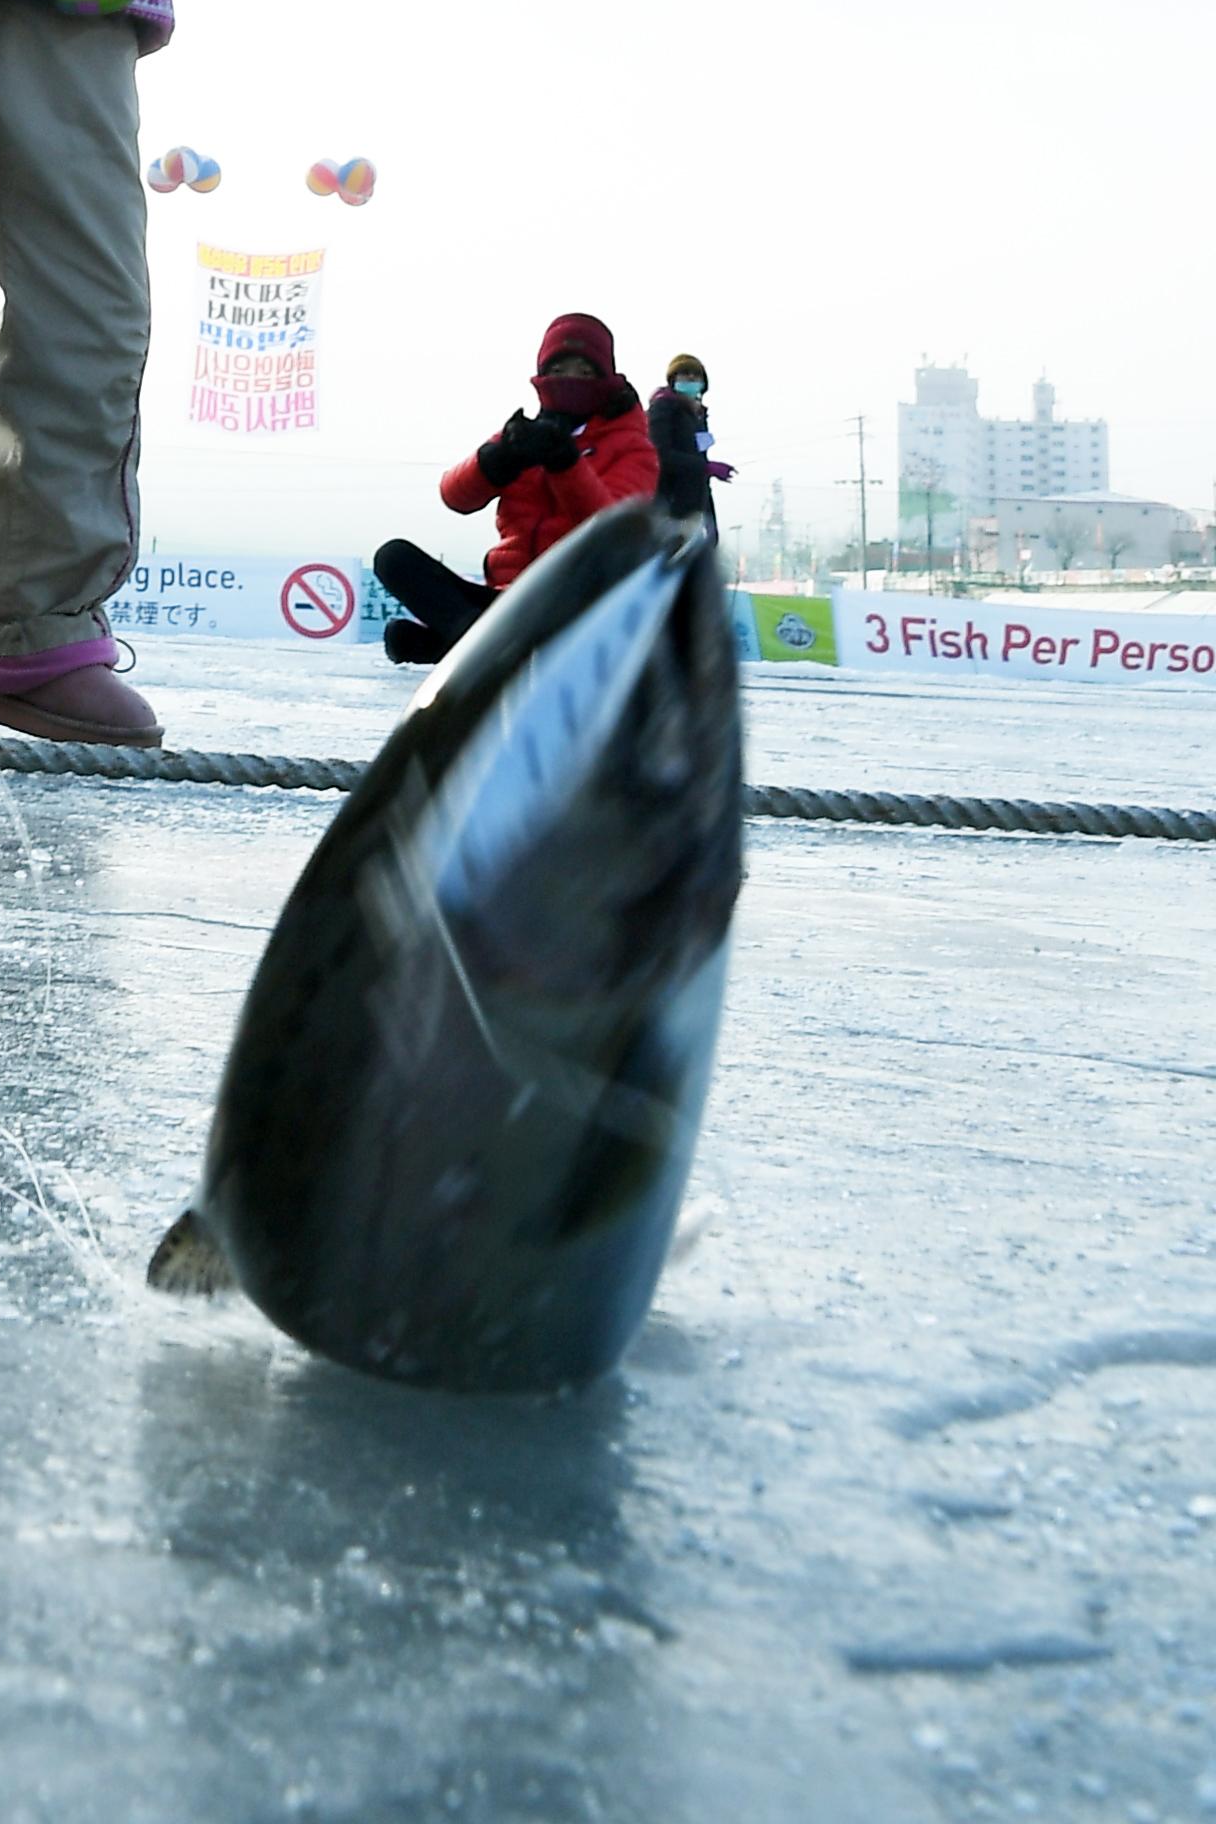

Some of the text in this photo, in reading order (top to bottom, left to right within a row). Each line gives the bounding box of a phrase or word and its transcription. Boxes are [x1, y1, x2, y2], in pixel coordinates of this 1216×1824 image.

[160, 561, 244, 594] place.
[102, 600, 217, 629] 禁煙です。
[865, 613, 1215, 673] 3 Fish Per Perso
